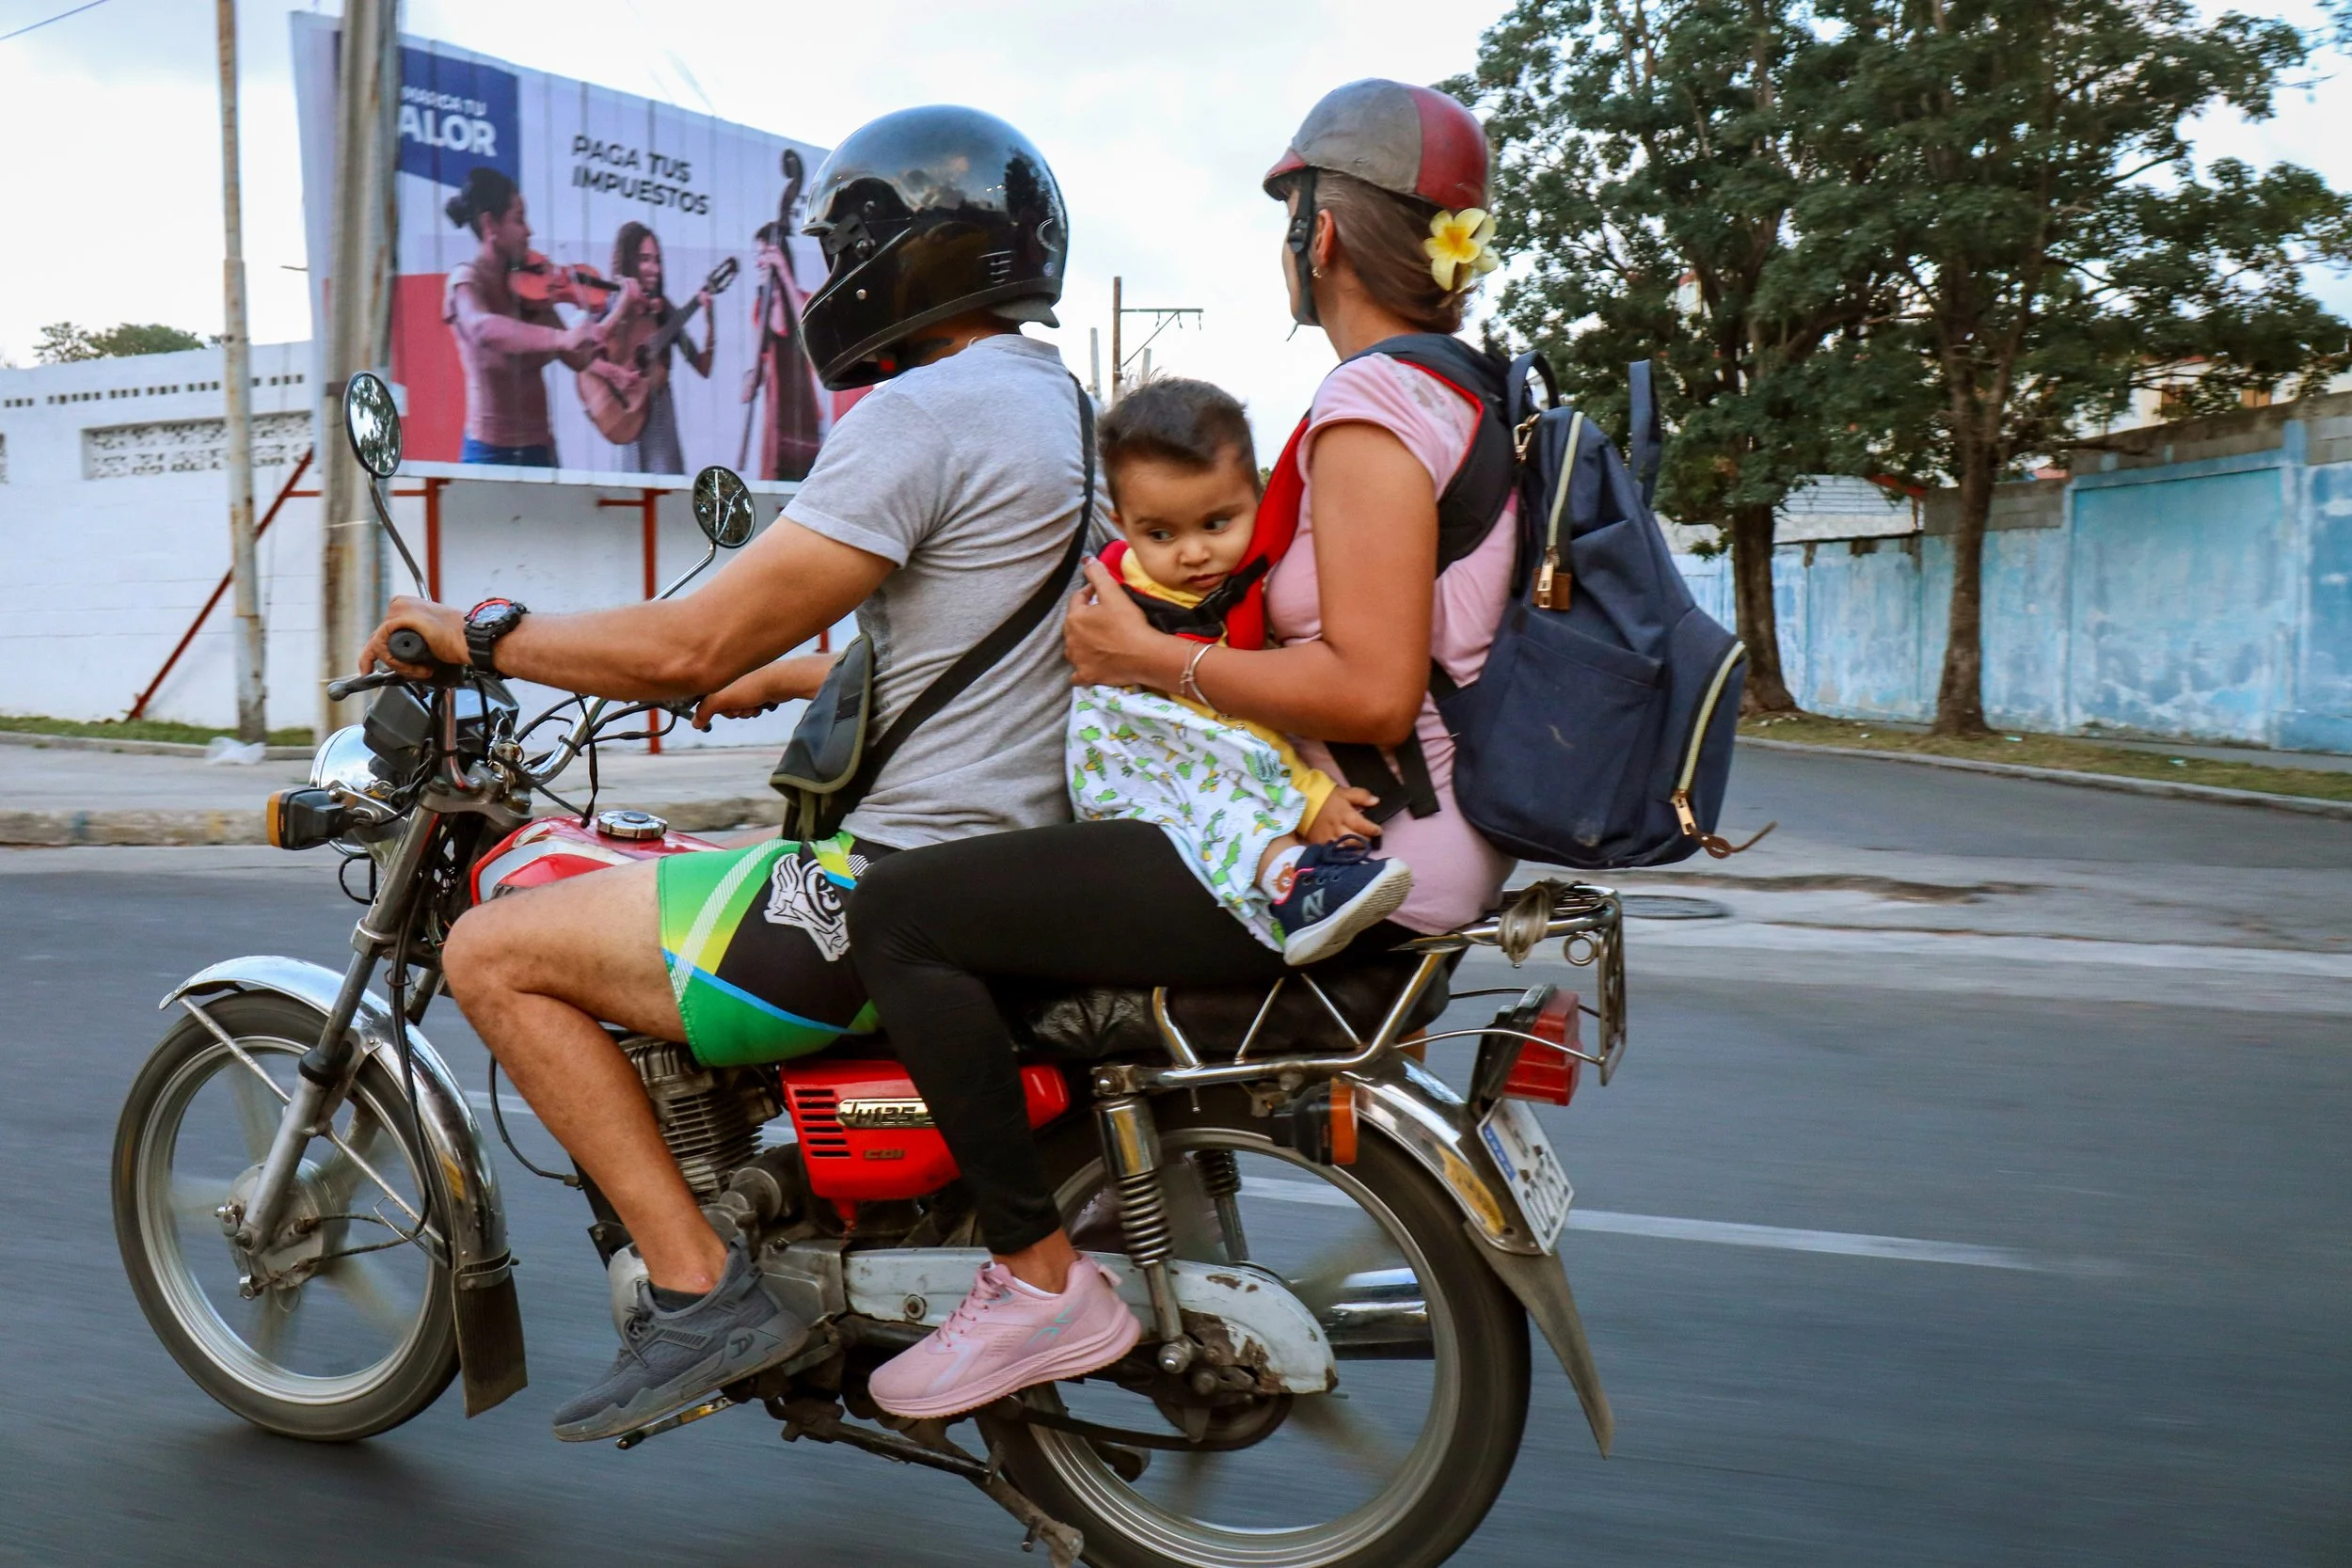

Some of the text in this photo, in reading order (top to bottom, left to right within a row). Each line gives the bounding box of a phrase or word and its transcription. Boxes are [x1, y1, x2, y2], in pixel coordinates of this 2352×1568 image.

[398, 104, 498, 157] ALOR
[571, 135, 691, 182] PAGA TUS
[572, 165, 710, 214] IMPUESTOS
